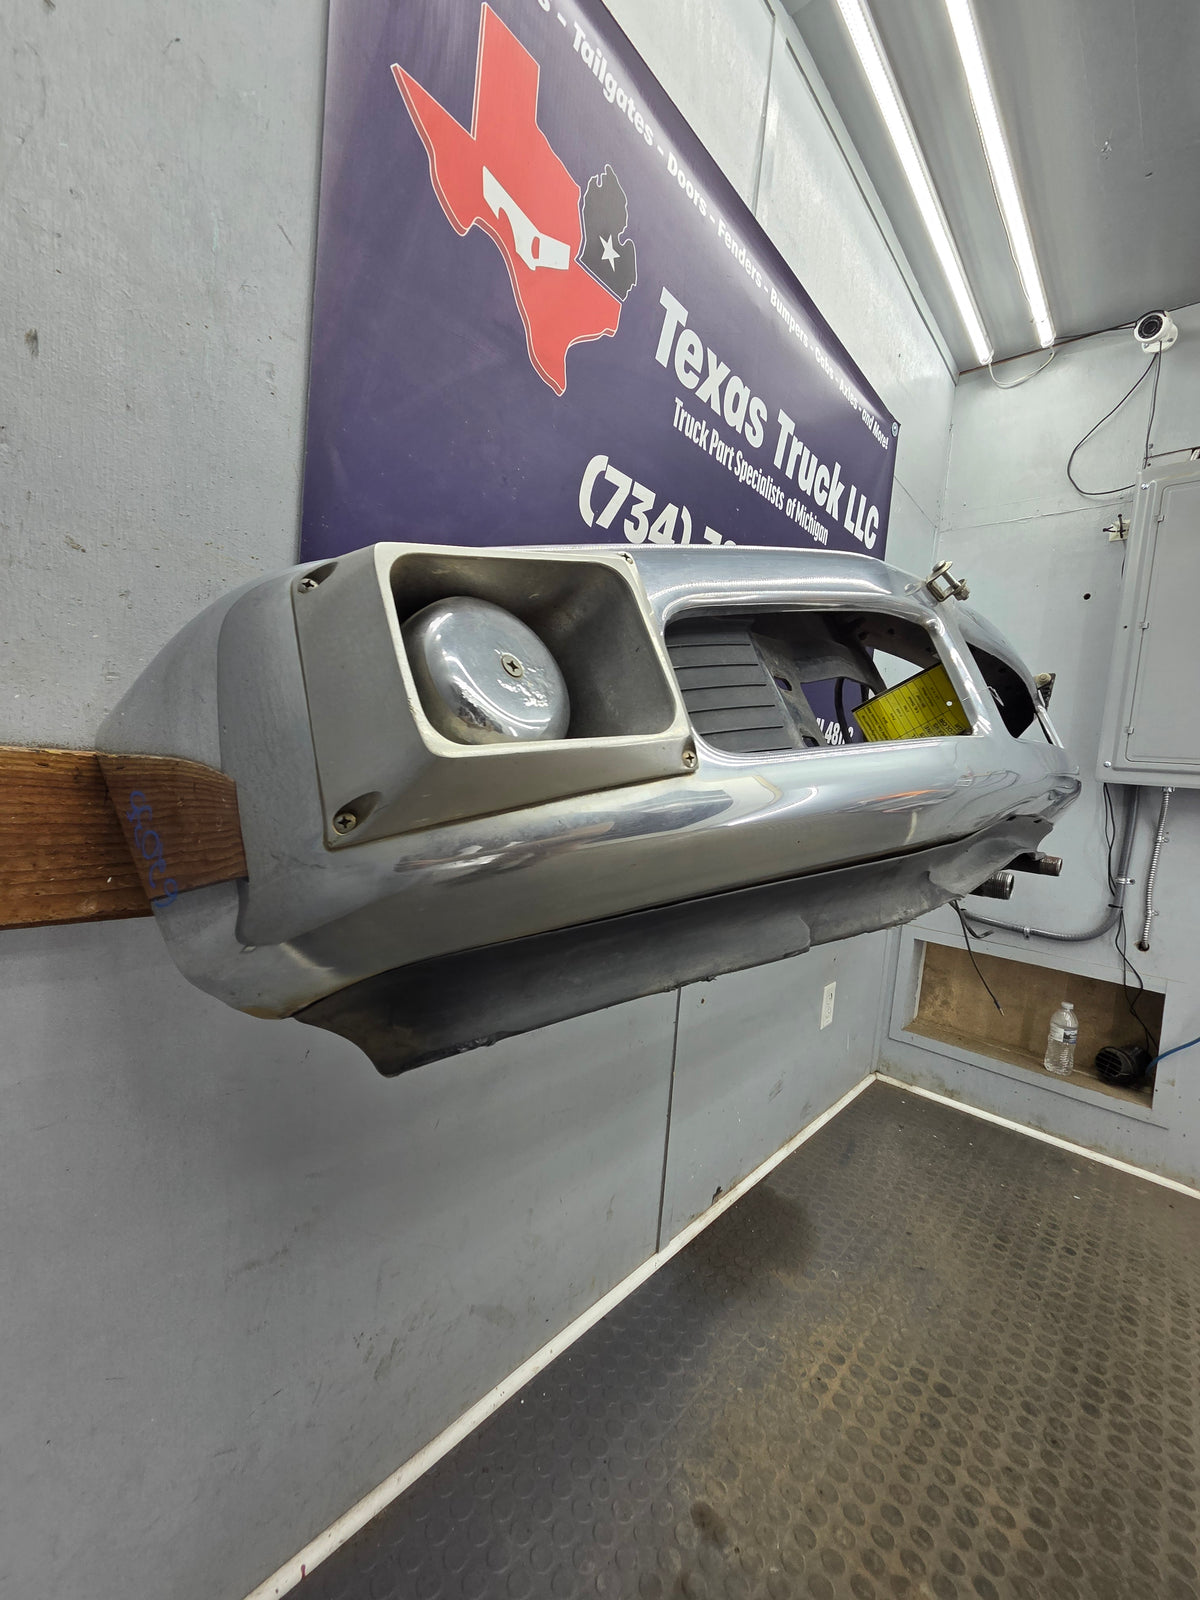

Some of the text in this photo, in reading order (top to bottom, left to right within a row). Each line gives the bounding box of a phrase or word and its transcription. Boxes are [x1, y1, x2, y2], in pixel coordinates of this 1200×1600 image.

[572, 21, 654, 146] Tailgates
[667, 152, 708, 217] Doors
[717, 218, 763, 292] Fenders
[770, 287, 809, 348] Bumpers
[861, 409, 875, 431] and
[872, 421, 889, 450] More!
[579, 455, 692, 545] (734)
[655, 286, 768, 448] Texas
[773, 409, 845, 521] Truck
[843, 485, 879, 550] LLC
[672, 397, 830, 546] Truck Part Specialists of Michigan
